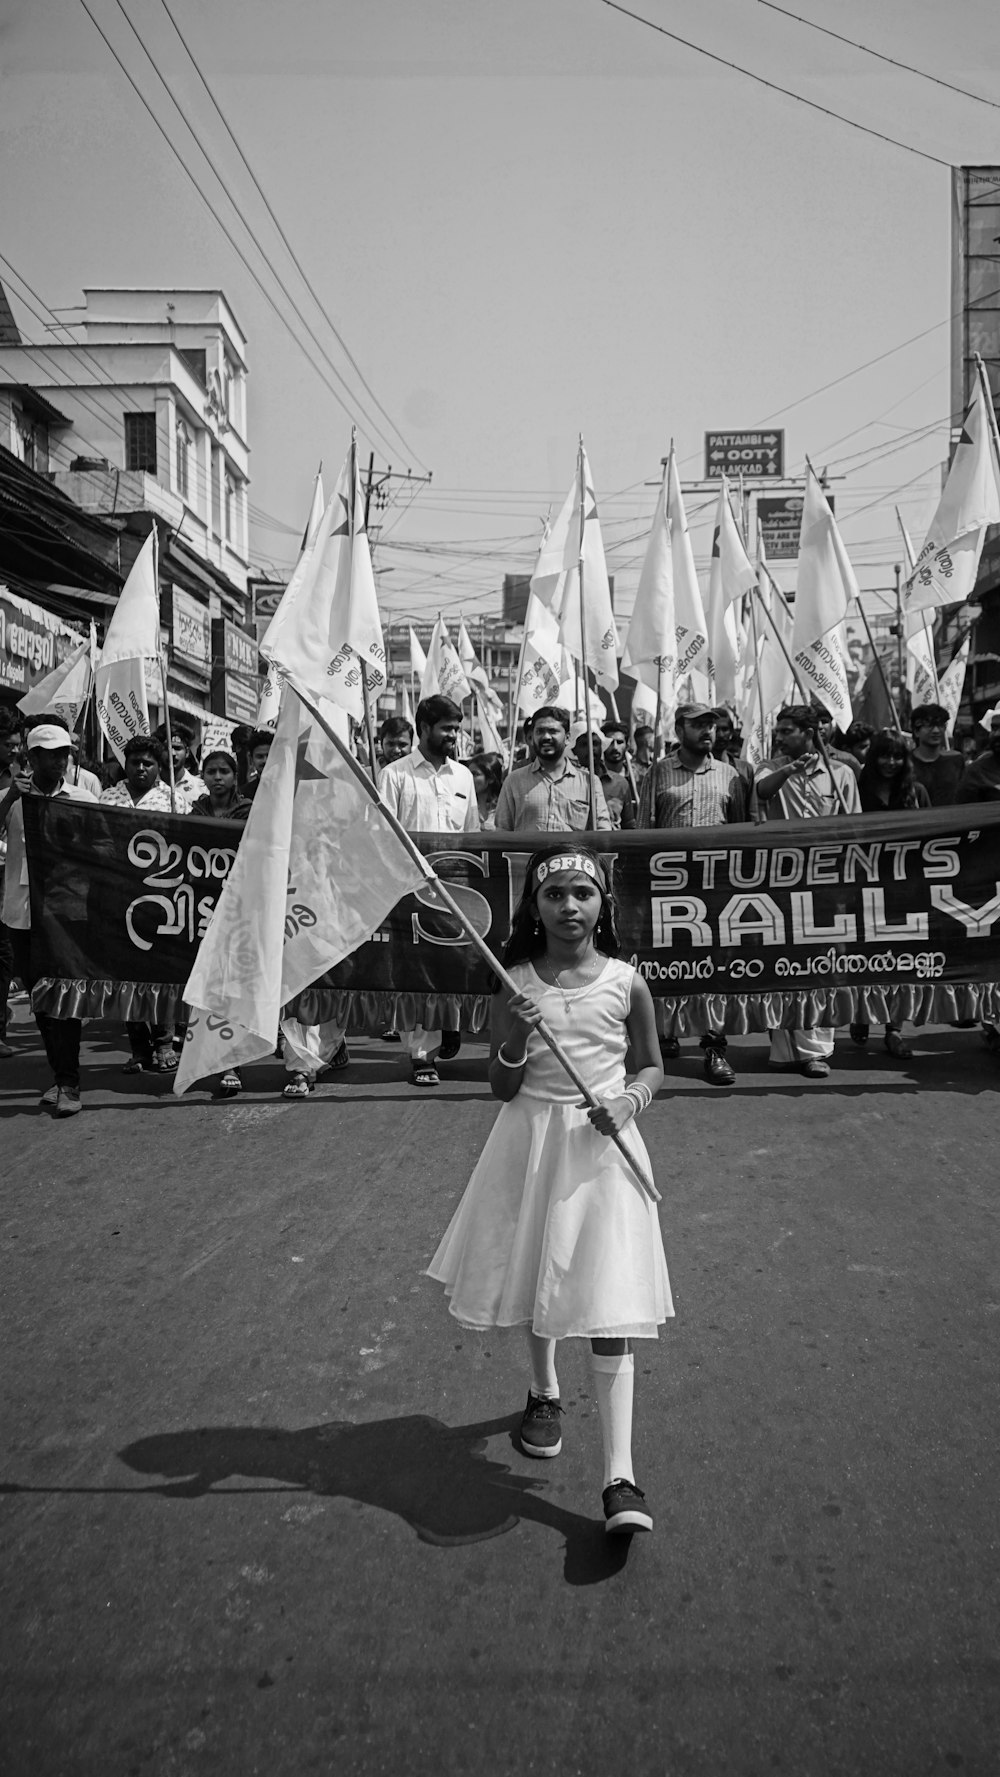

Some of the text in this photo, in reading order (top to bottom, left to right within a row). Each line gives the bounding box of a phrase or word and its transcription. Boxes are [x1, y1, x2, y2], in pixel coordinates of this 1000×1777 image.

[710, 435, 762, 446] PATTAMBI
[727, 448, 778, 460] OOTY
[710, 464, 762, 475] PALAKKAD
[549, 855, 584, 873] SFI
[651, 881, 1000, 948] RALLY
[774, 947, 947, 978] പെരിന്തൽമണ്ണ
